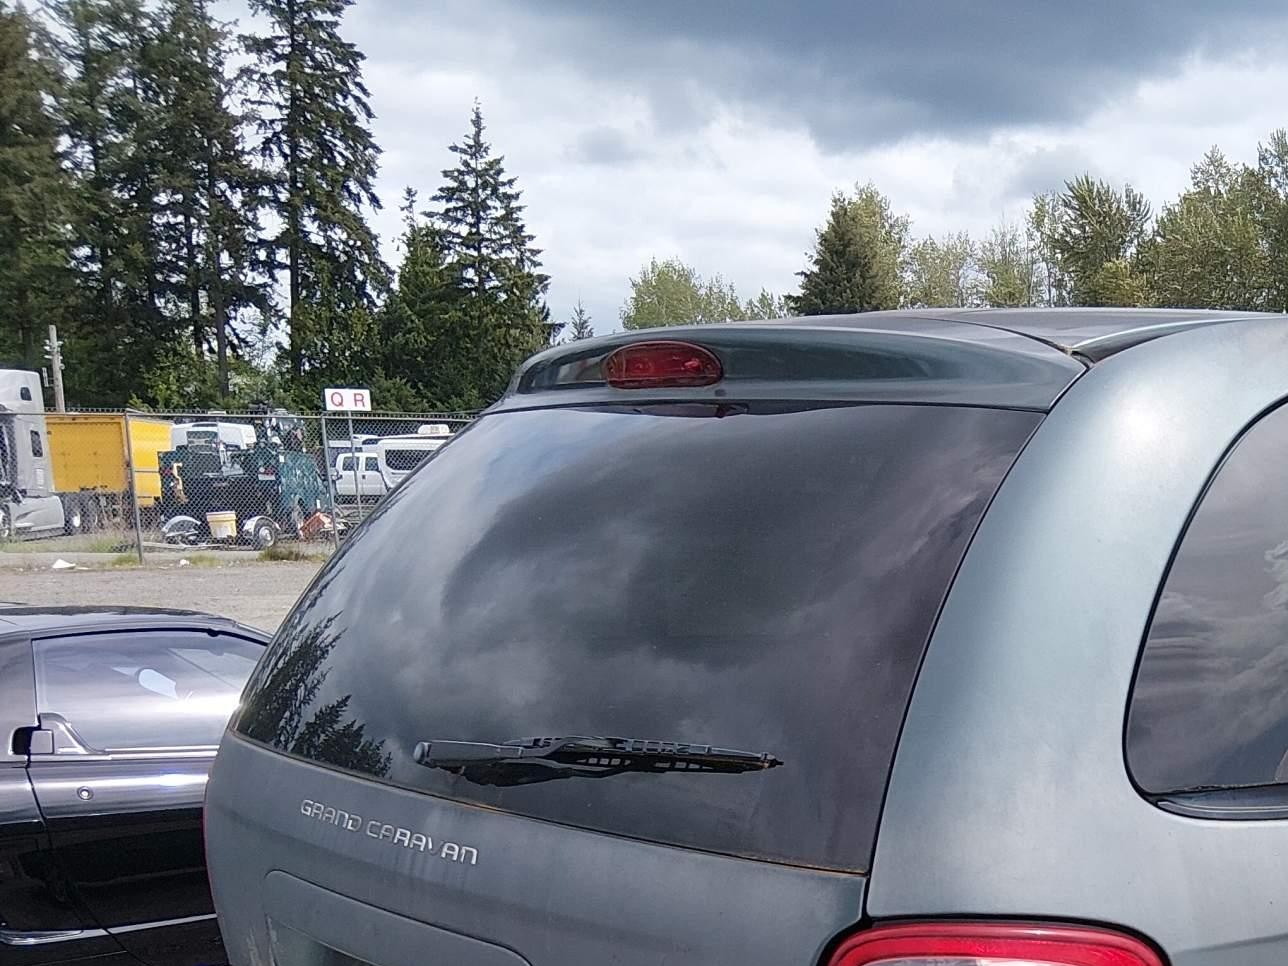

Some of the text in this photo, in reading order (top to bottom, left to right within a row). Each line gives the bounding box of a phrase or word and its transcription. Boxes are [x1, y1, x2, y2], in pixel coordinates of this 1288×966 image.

[330, 391, 365, 407] Q R
[300, 799, 479, 865] GRAND CARAVAN
